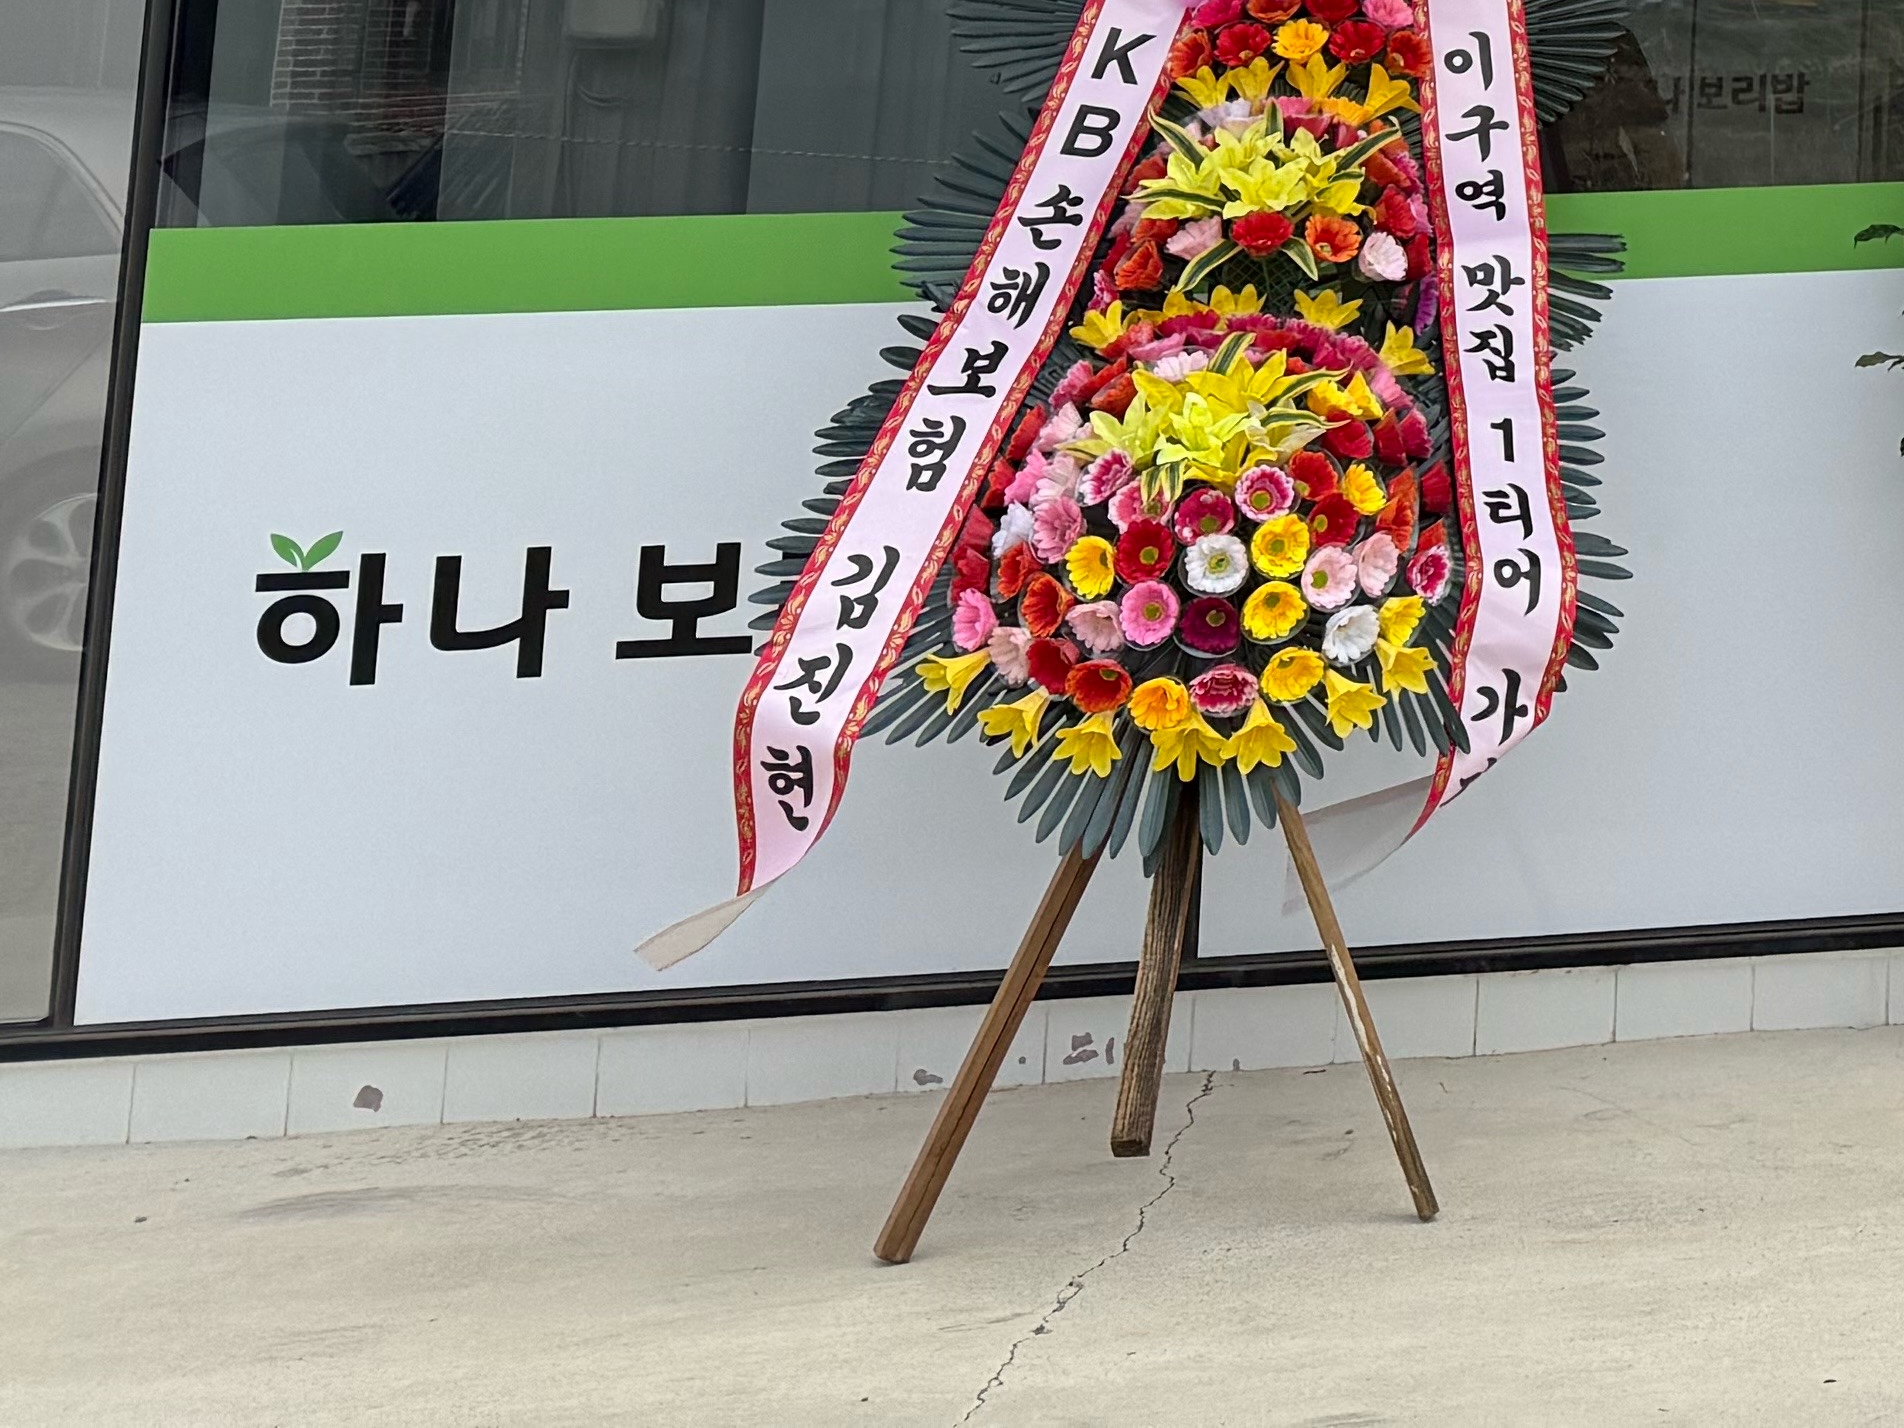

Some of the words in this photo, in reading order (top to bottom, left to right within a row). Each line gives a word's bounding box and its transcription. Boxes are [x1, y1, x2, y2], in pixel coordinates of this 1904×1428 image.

[1443, 30, 1510, 223] 이구역
[1697, 70, 1811, 115] 보리밥
[905, 26, 1157, 493] KB손해보험
[1461, 253, 1526, 384] 맛집
[255, 534, 570, 686] 하나
[1482, 416, 1542, 617] 1티어
[759, 544, 902, 832] 김진현
